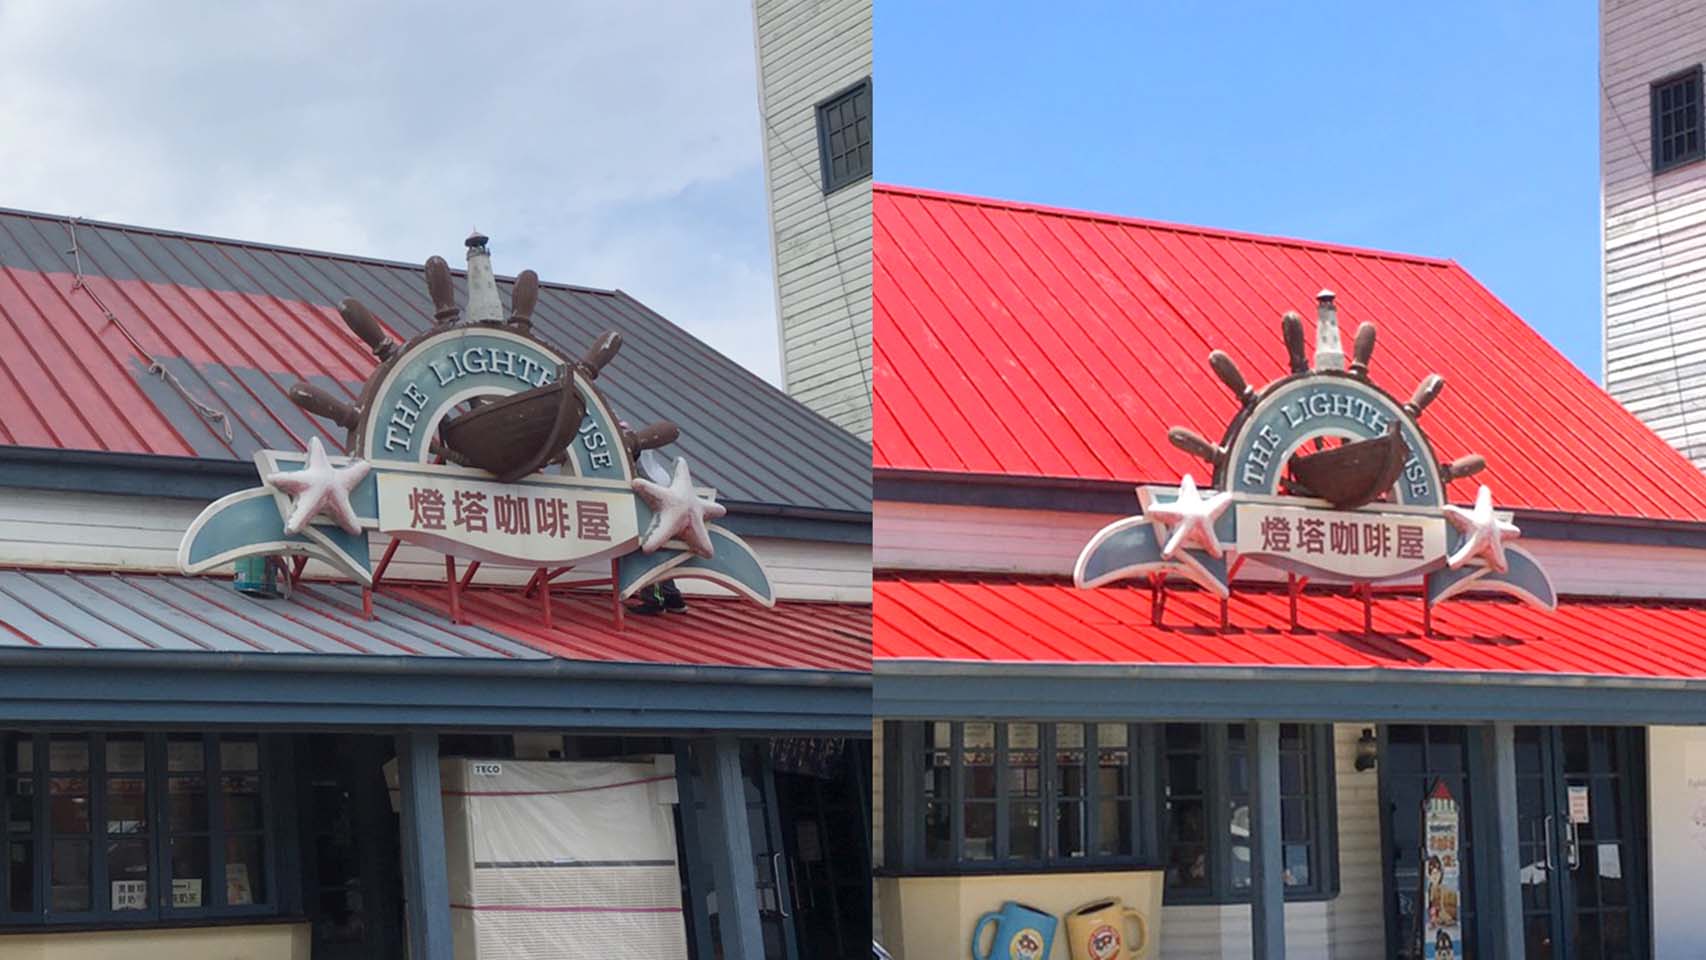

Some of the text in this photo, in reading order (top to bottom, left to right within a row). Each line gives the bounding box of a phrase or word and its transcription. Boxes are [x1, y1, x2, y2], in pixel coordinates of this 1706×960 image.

[385, 347, 612, 468] THE LIGHTHSE
[1243, 393, 1428, 497] THE LIGHTHSE
[408, 487, 612, 542] 燈塔咖啡屋
[1261, 516, 1425, 560] 燈塔咖啡屋
[475, 765, 500, 774] TECO
